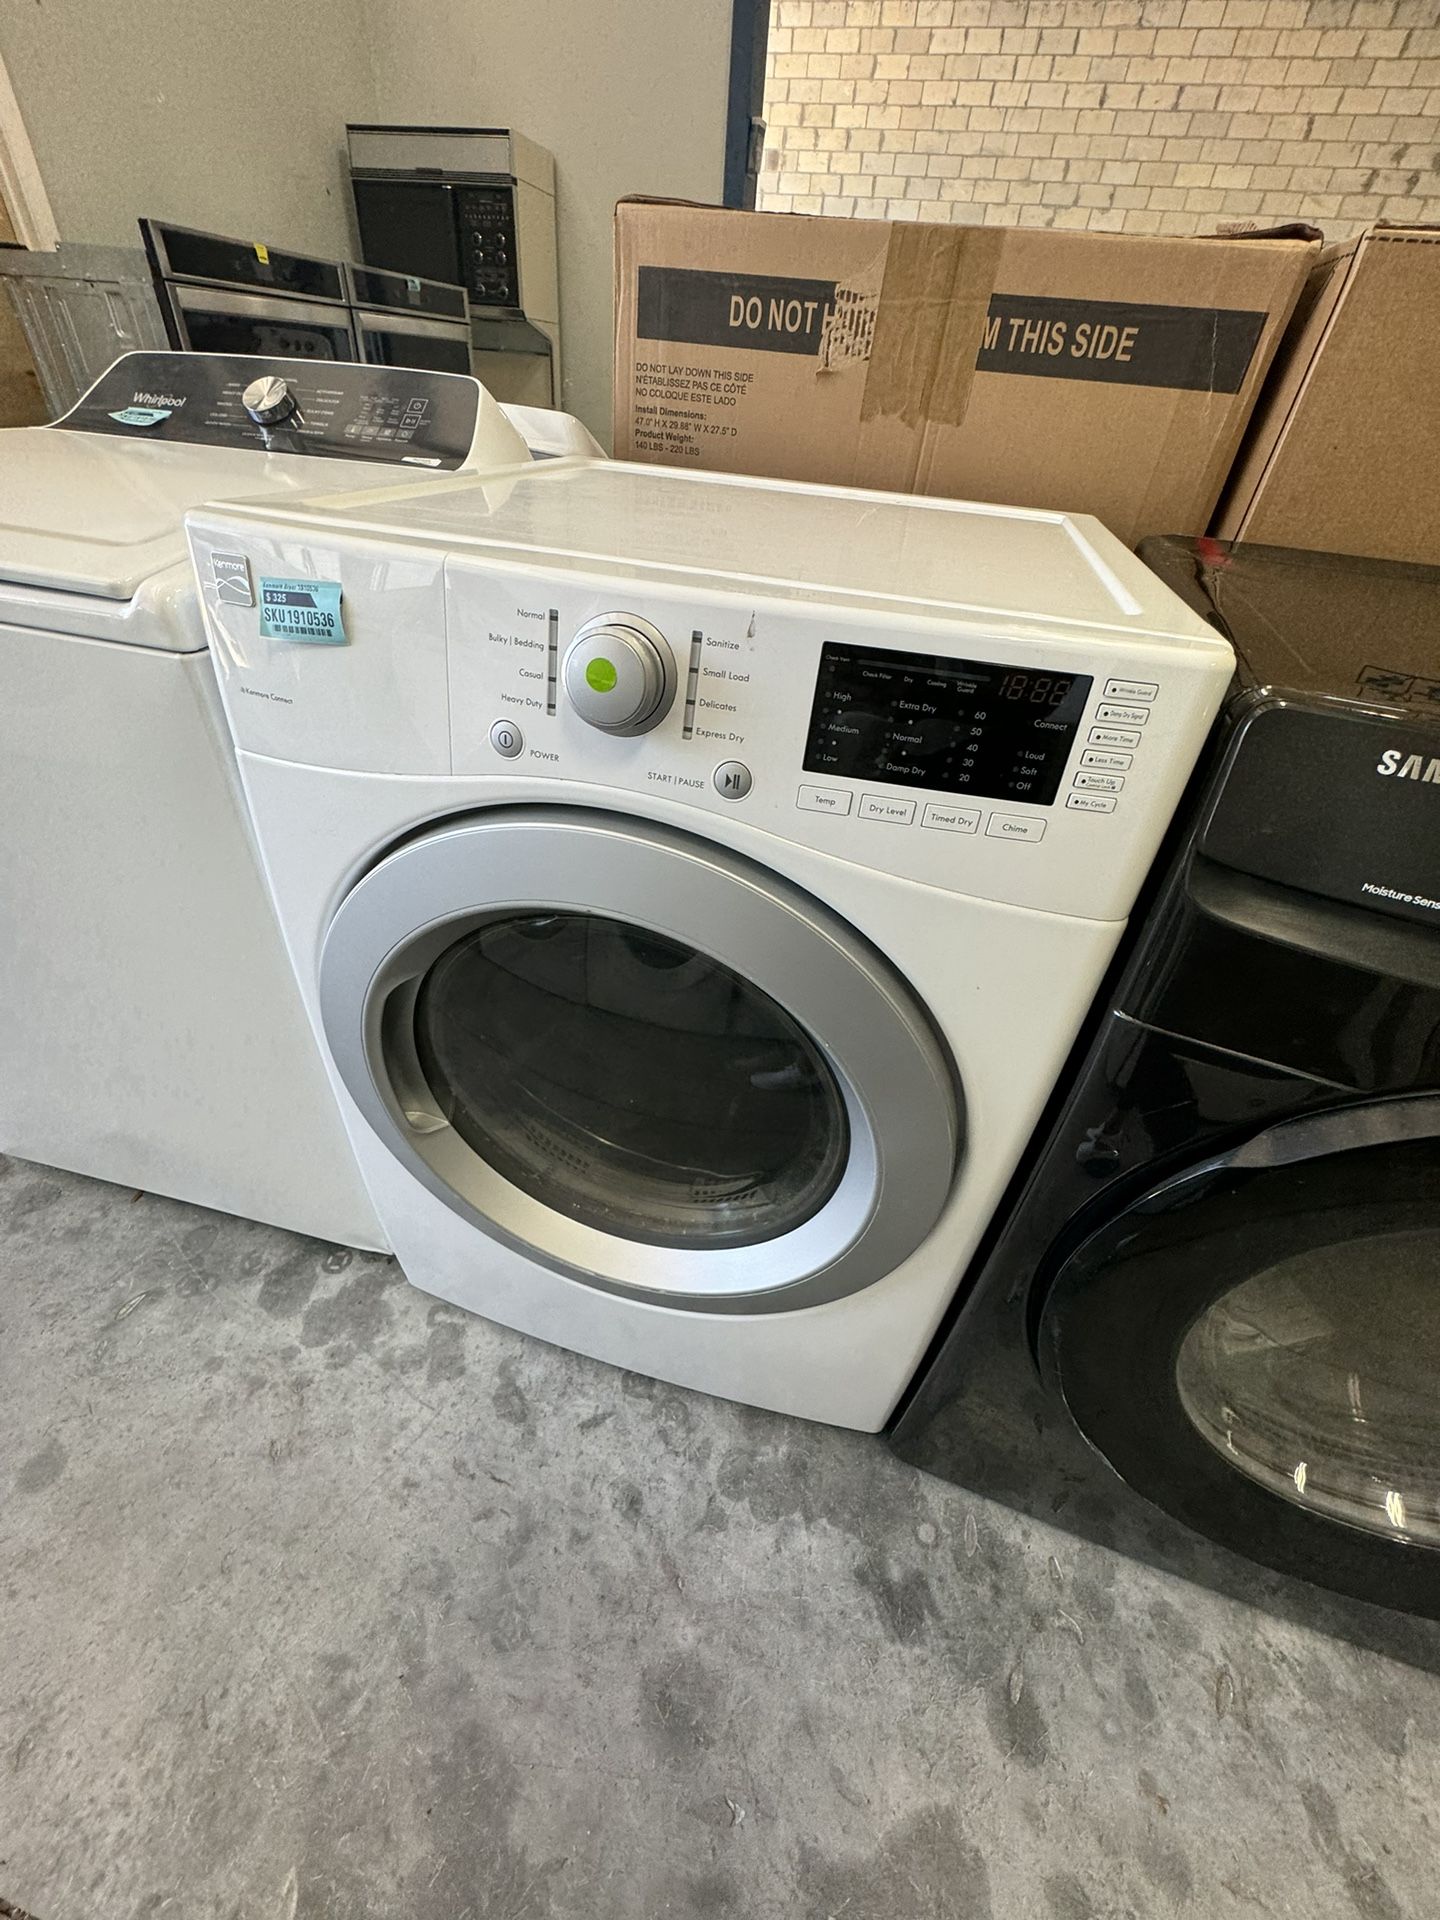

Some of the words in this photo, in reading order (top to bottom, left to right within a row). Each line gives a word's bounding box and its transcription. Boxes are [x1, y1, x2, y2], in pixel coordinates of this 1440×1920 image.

[729, 295, 763, 329] DO
[768, 298, 818, 334] NOT
[1008, 318, 1067, 356] THIS
[1071, 323, 1139, 362] SIDE
[636, 362, 648, 372] DO
[650, 363, 667, 374] NOT
[668, 365, 684, 376] LAY
[685, 367, 711, 379] DOWN
[713, 370, 732, 381] THIS
[734, 371, 754, 383] SIDE
[692, 380, 708, 391] PAS
[710, 382, 722, 392] CE
[723, 382, 747, 395] CÔTÉ
[133, 391, 187, 407] Whirlpool
[635, 387, 648, 397] NO
[649, 388, 689, 401] COLOQUE
[690, 393, 711, 404] ESTE
[713, 396, 737, 406] LADO
[635, 404, 657, 415] Install
[659, 407, 707, 421] Dimensions:
[635, 428, 664, 440] Product
[665, 431, 694, 444] Weight:
[693, 423, 702, 432] W
[731, 428, 738, 437] D
[635, 441, 648, 450] 140
[649, 442, 664, 452] LBS
[670, 444, 684, 454] 220
[684, 446, 700, 456] LBS
[214, 559, 245, 572] Kenmore
[266, 592, 271, 601] $
[272, 593, 287, 603] 325
[264, 607, 286, 623] SKU
[287, 609, 335, 628] 1910536
[517, 608, 545, 621] Normal
[488, 633, 508, 646] Bulky
[514, 637, 545, 652] Bedding
[706, 637, 740, 651] Sanitize
[519, 668, 544, 680] Casual
[703, 667, 727, 680] Small
[729, 671, 750, 683] Load
[904, 676, 914, 684] Dry
[501, 693, 524, 706] Heavy
[526, 698, 543, 710] Duty
[833, 691, 852, 703] High
[699, 698, 737, 712] Delicates
[899, 700, 920, 711] Extra
[922, 703, 937, 714] Dry
[974, 711, 987, 721] 60
[828, 724, 860, 735] Medium
[970, 727, 983, 736] 50
[1034, 719, 1068, 731] Connect
[696, 727, 726, 741] Express
[729, 731, 745, 744] Dry
[892, 733, 923, 744] Normal
[1102, 734, 1118, 742] More
[1119, 736, 1134, 744] Time
[966, 743, 979, 752] 40
[530, 749, 560, 762] POWER
[823, 754, 838, 762] Low
[1025, 750, 1045, 761] Loud
[1094, 756, 1108, 764] Less
[1109, 758, 1124, 766] Time
[962, 758, 974, 767] 30
[886, 762, 910, 774] Damp
[912, 766, 926, 777] Dry
[1020, 766, 1038, 776] Soft
[647, 771, 672, 783] START
[678, 777, 705, 790] PAUSE
[959, 773, 971, 782] 20
[1106, 778, 1116, 786] Up
[1016, 781, 1032, 791] Off
[815, 795, 836, 807] Temp
[1080, 799, 1089, 807] My
[1091, 800, 1107, 809] Cycle
[869, 803, 885, 815] Dry
[886, 806, 907, 817] Level
[931, 813, 955, 825] Timed
[957, 816, 974, 828] Dry
[1002, 823, 1028, 835] Chime
[1361, 882, 1413, 904] Moisture
